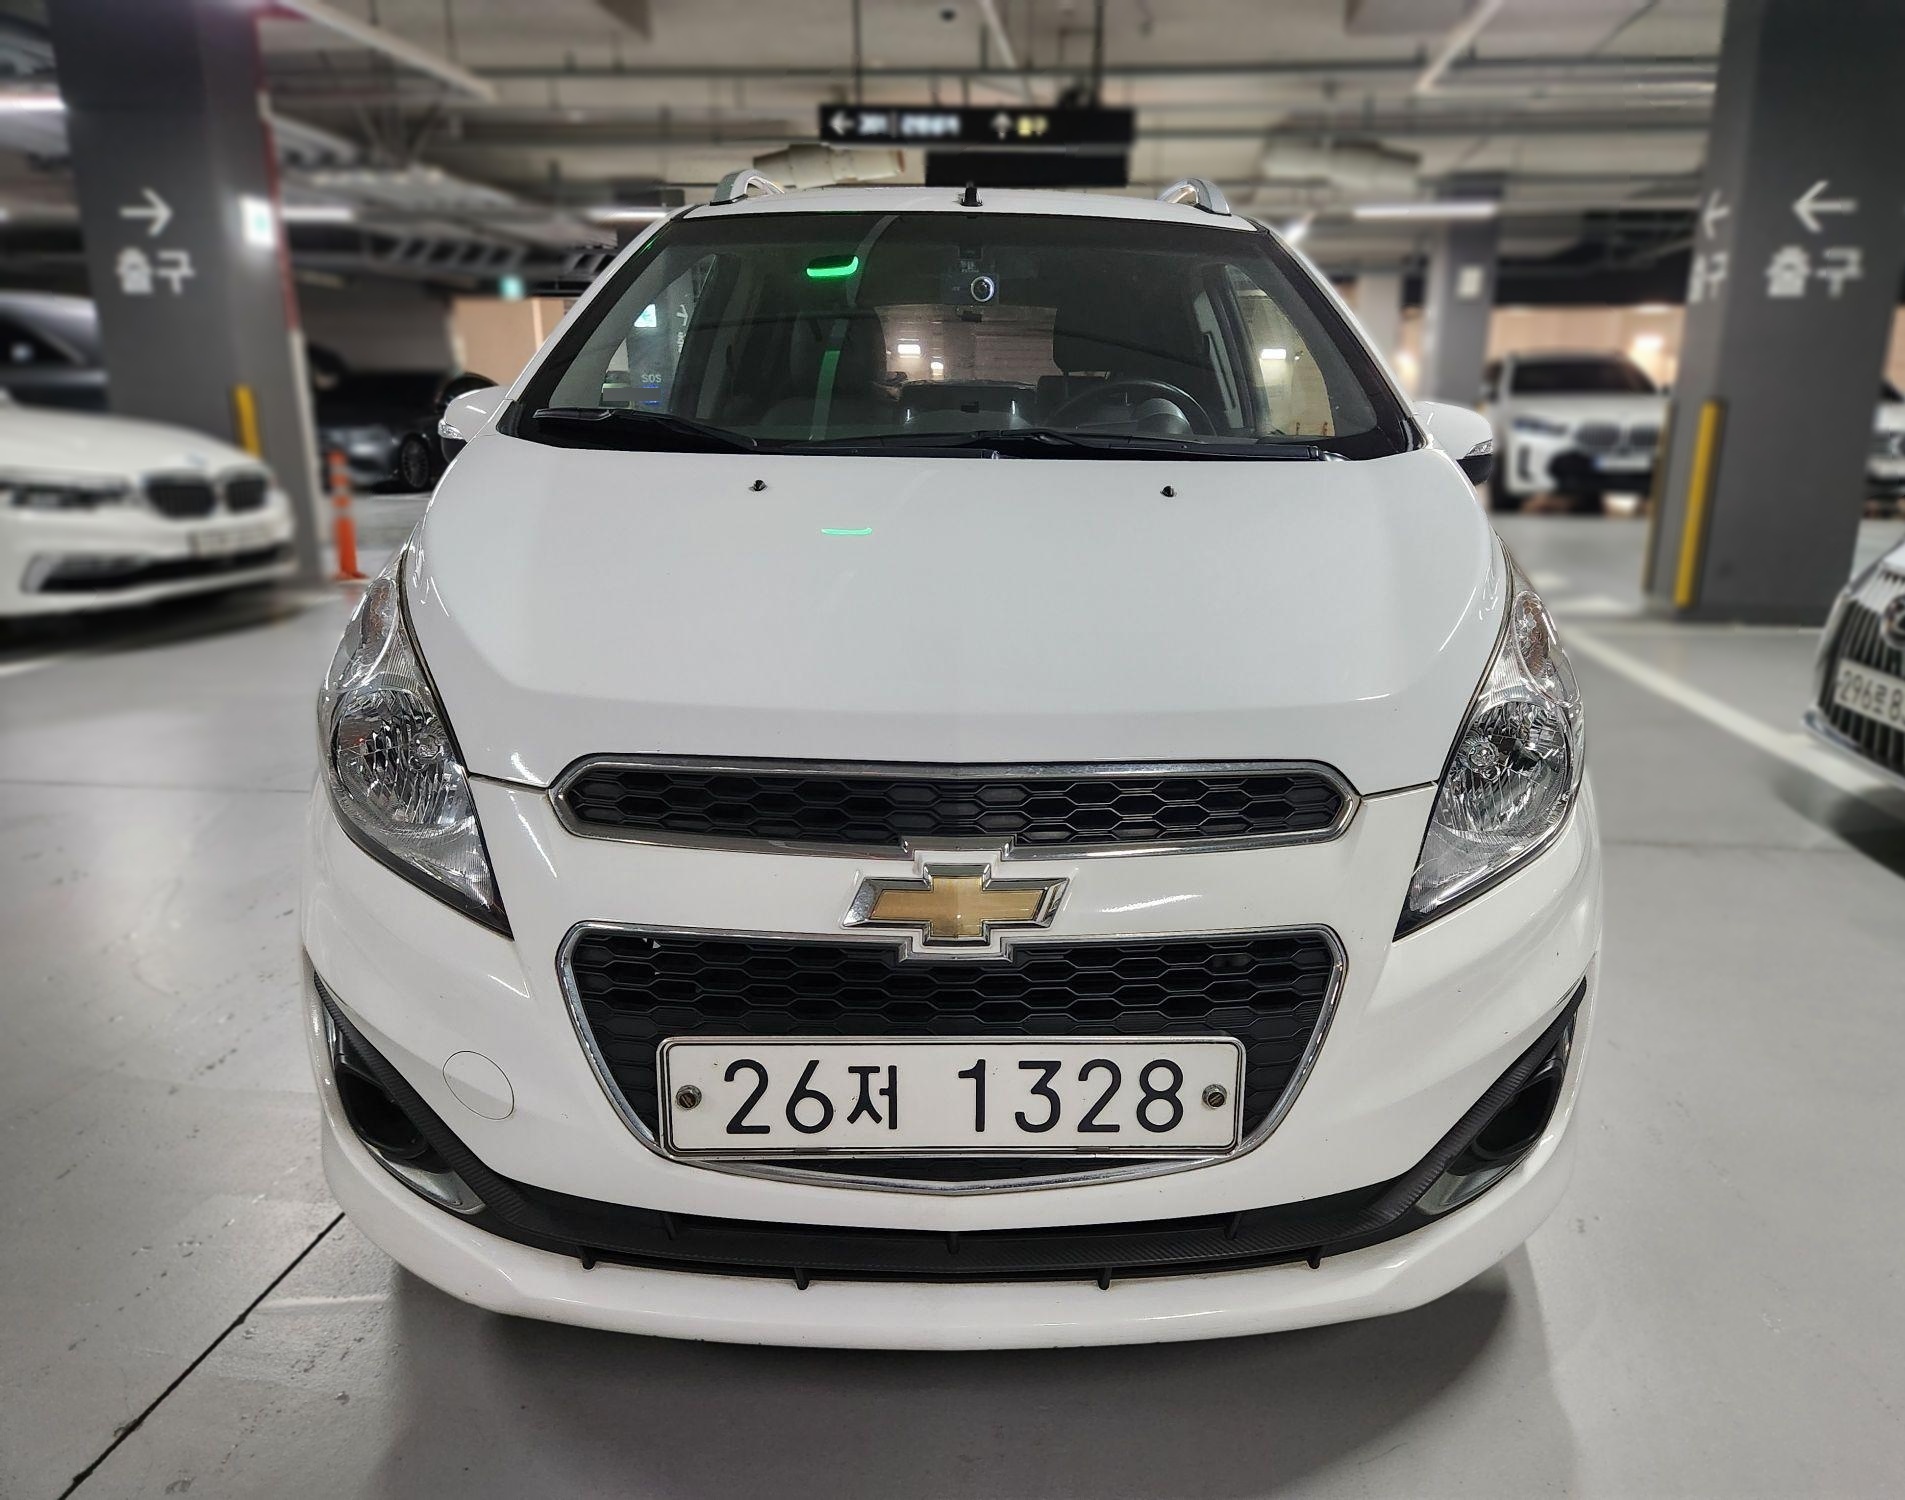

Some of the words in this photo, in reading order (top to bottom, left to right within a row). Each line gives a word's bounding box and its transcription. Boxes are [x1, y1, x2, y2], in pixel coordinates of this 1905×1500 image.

[641, 373, 662, 383] SOS
[724, 1058, 898, 1134] 26저
[957, 1058, 1183, 1133] 1328
